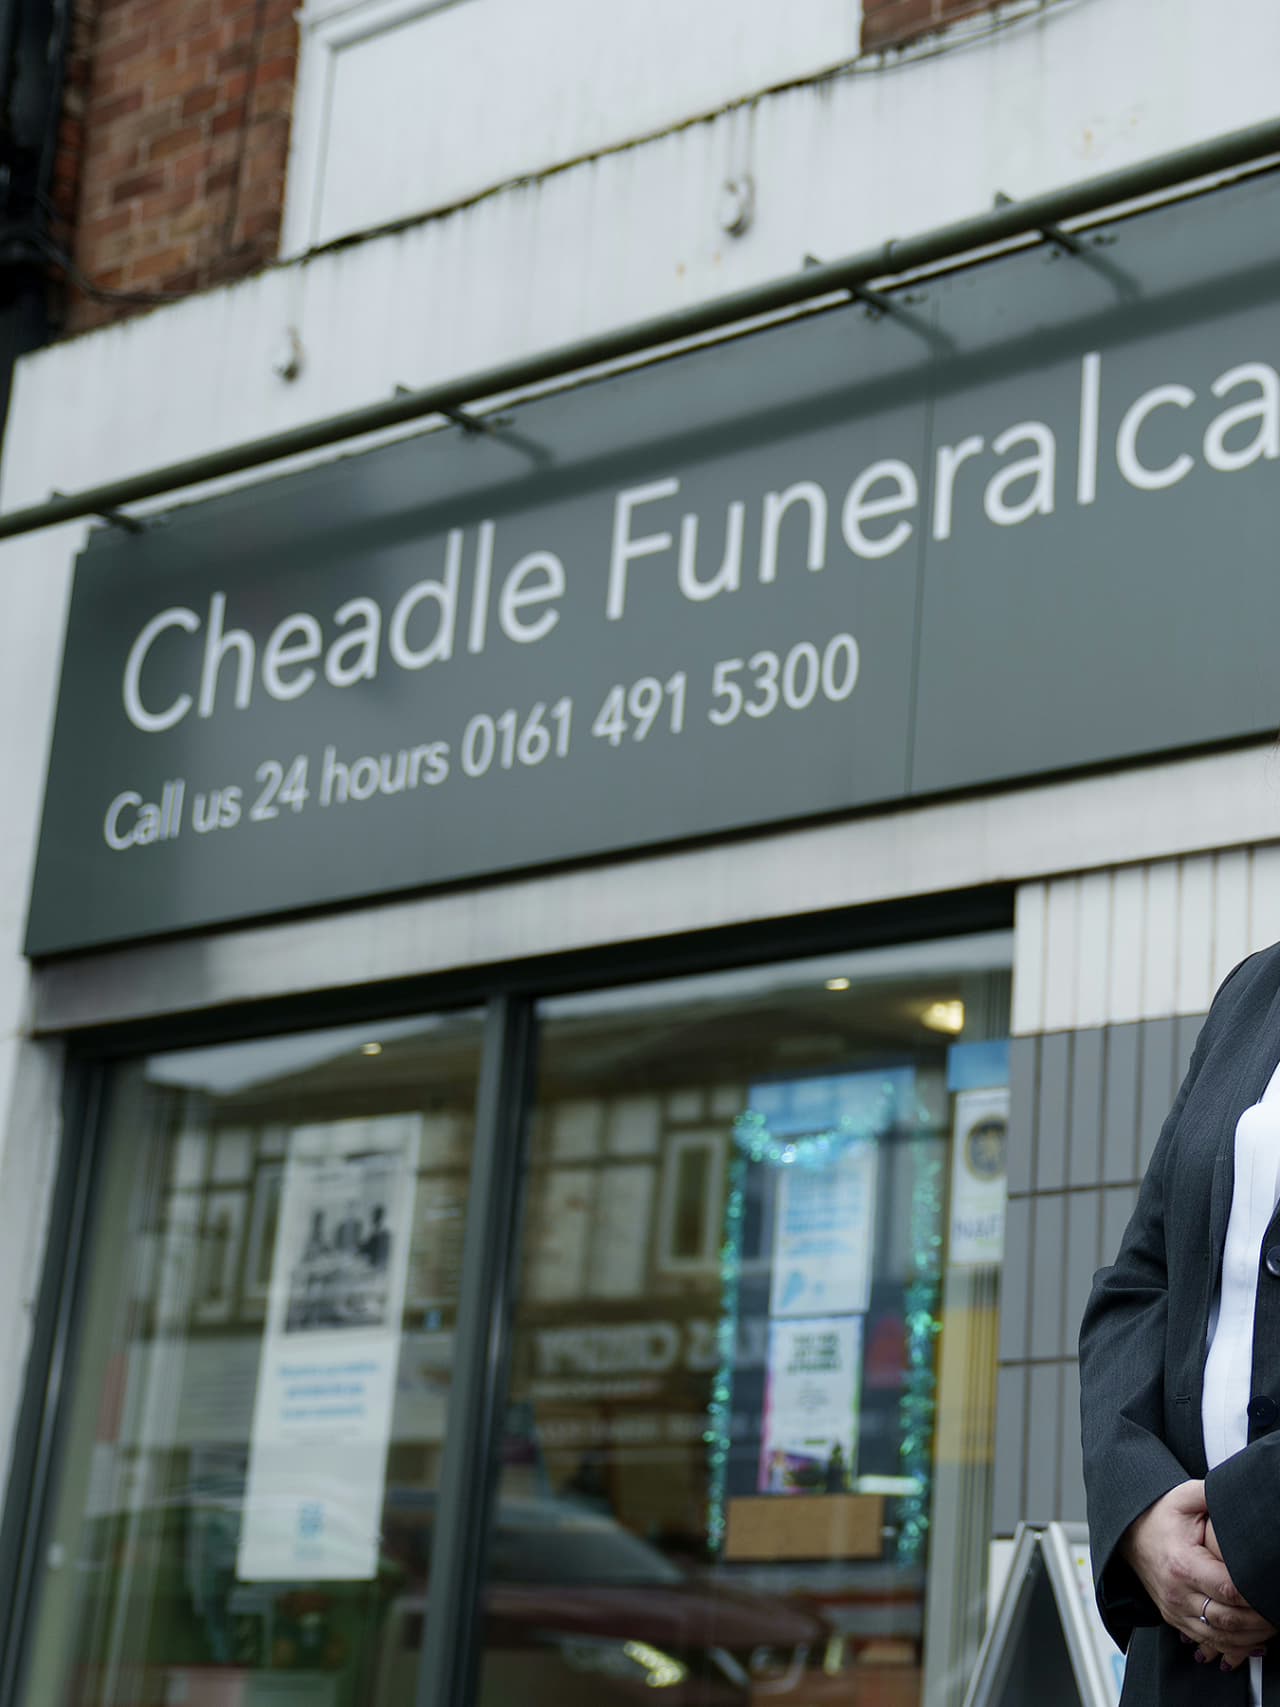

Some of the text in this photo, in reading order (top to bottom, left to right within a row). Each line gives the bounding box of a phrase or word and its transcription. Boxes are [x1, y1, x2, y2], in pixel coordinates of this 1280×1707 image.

[123, 520, 567, 733] Cheadle
[103, 632, 861, 851] Call us 24 hours 0161 491 5300
